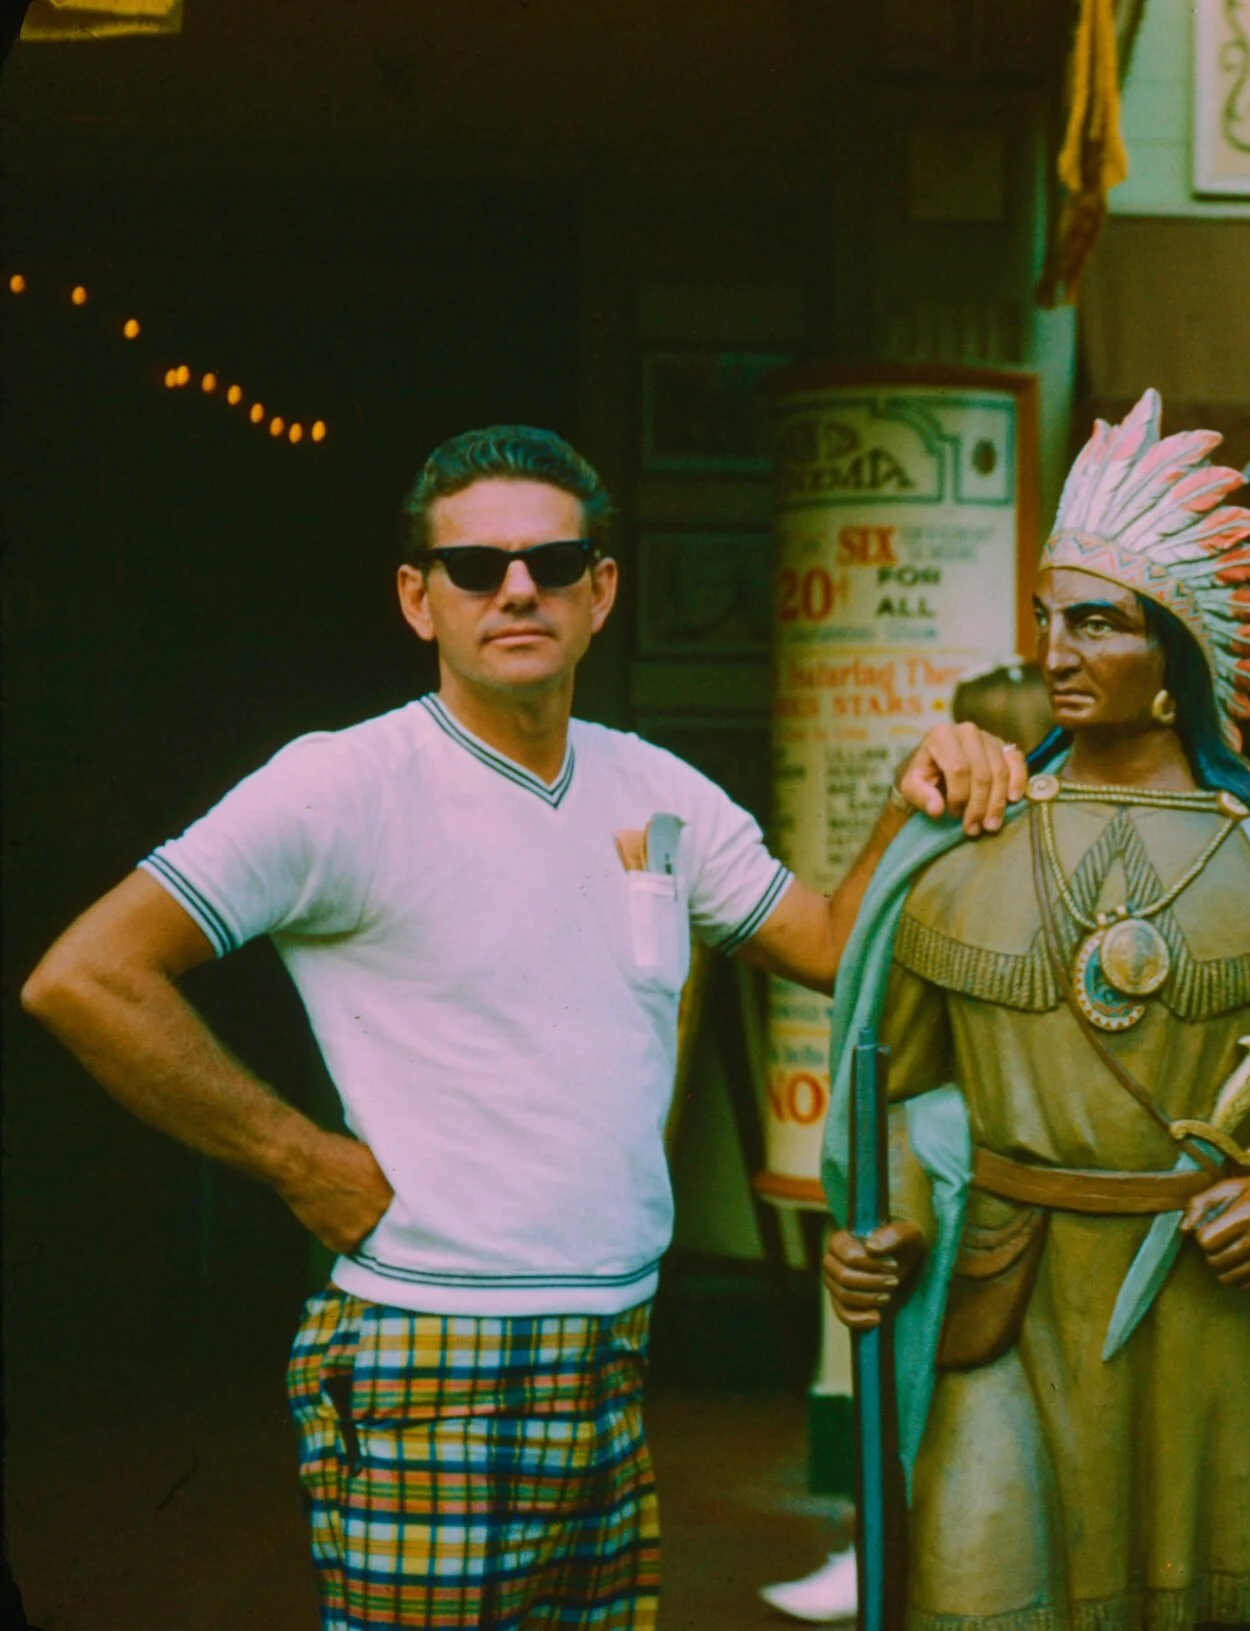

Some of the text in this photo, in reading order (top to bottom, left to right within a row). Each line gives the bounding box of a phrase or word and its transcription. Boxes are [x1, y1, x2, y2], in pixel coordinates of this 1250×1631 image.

[837, 525, 897, 566] SIX
[877, 566, 941, 586] FOR
[876, 596, 935, 618] ALL
